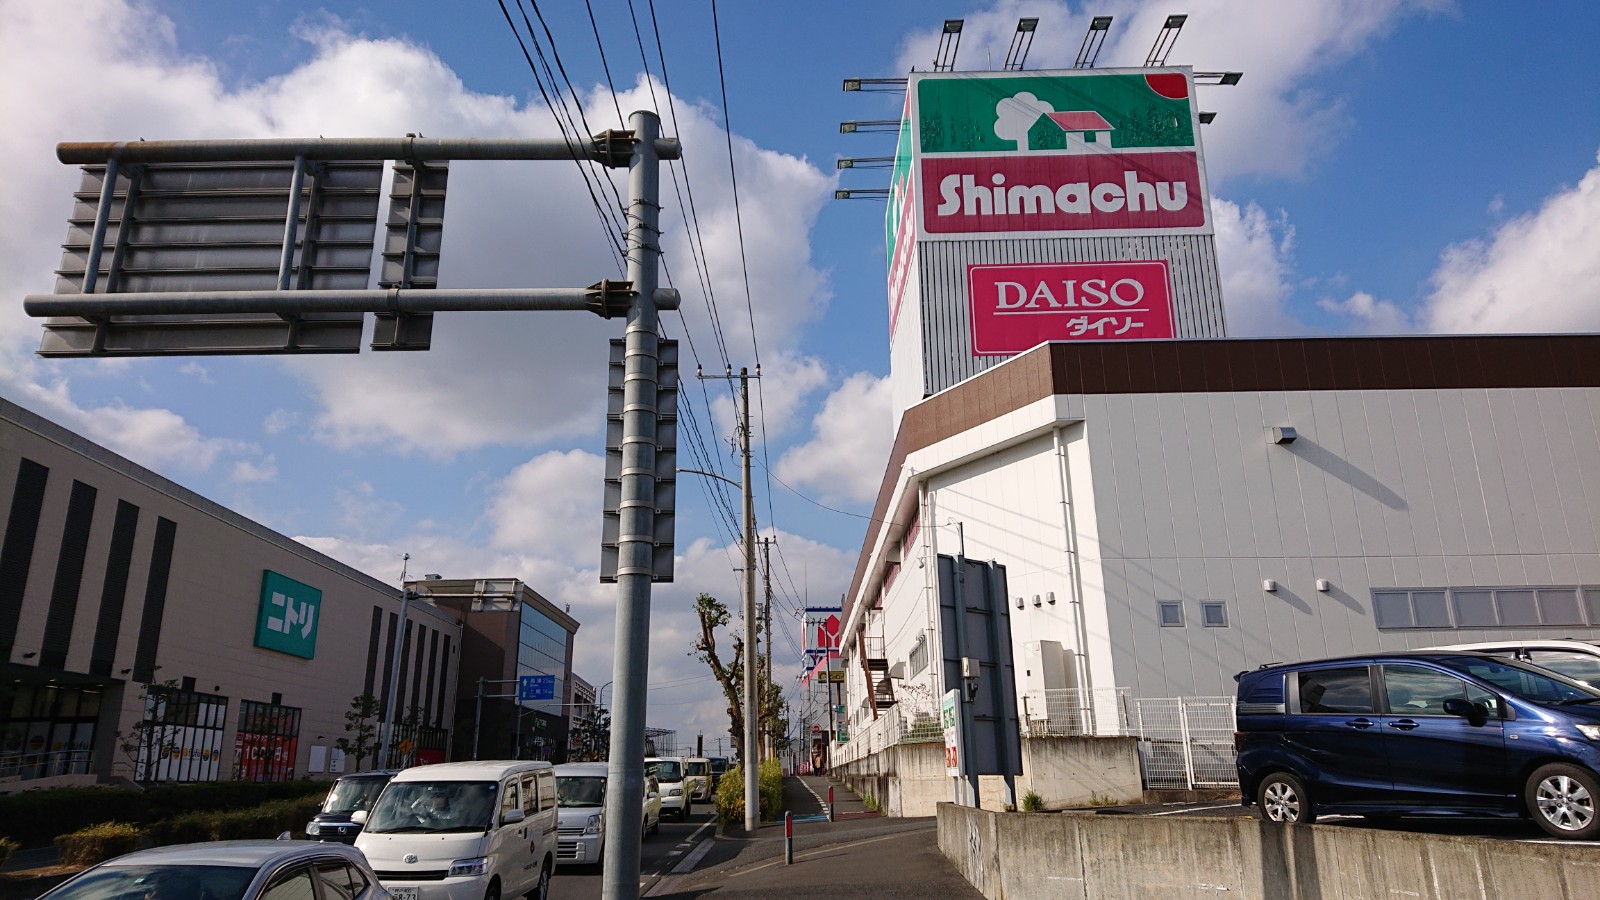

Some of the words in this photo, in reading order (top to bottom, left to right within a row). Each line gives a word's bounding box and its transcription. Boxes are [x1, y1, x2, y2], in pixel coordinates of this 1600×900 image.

[938, 171, 1188, 216] Shimachu
[994, 278, 1144, 309] DAISO
[1066, 315, 1144, 336] ダイソー
[267, 591, 315, 639] ニトリ
